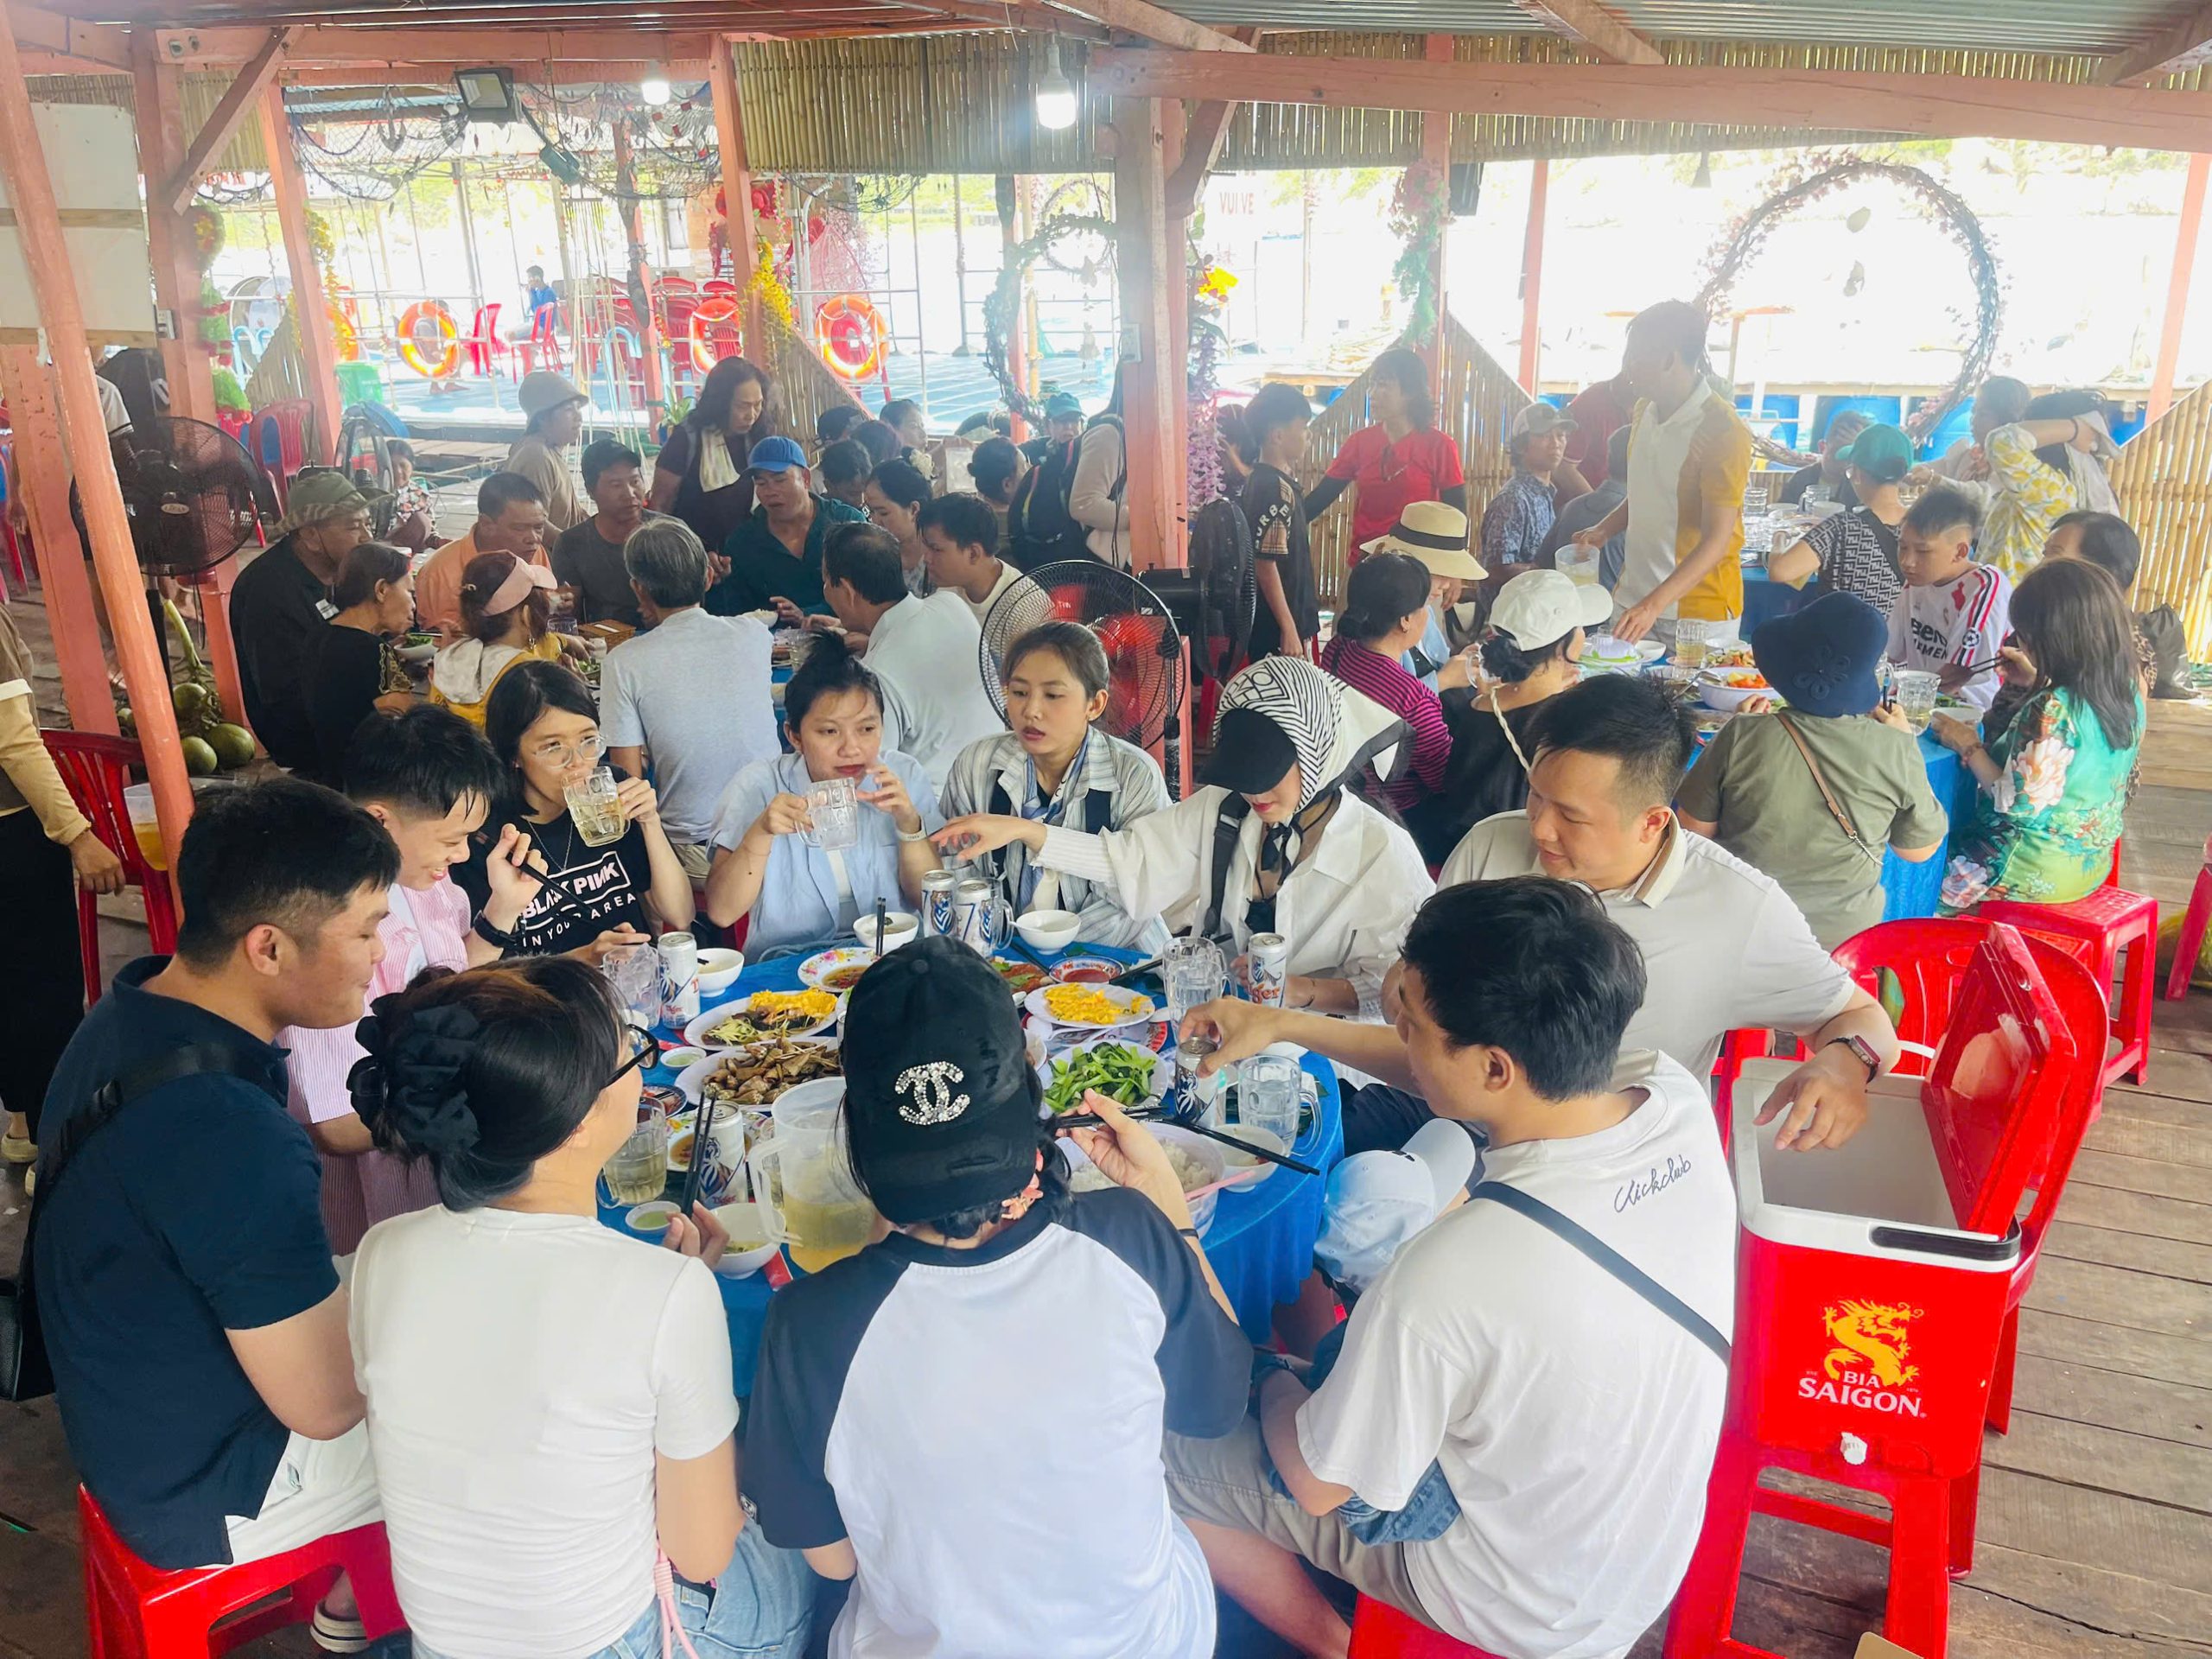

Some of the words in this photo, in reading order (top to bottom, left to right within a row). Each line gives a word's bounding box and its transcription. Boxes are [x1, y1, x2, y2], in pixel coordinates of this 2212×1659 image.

[523, 935, 542, 947] IN
[591, 893, 636, 919] AREA
[1247, 982, 1281, 1004] iger
[1843, 1370, 1880, 1388] BIA
[1798, 1377, 1922, 1417] SAIGON
